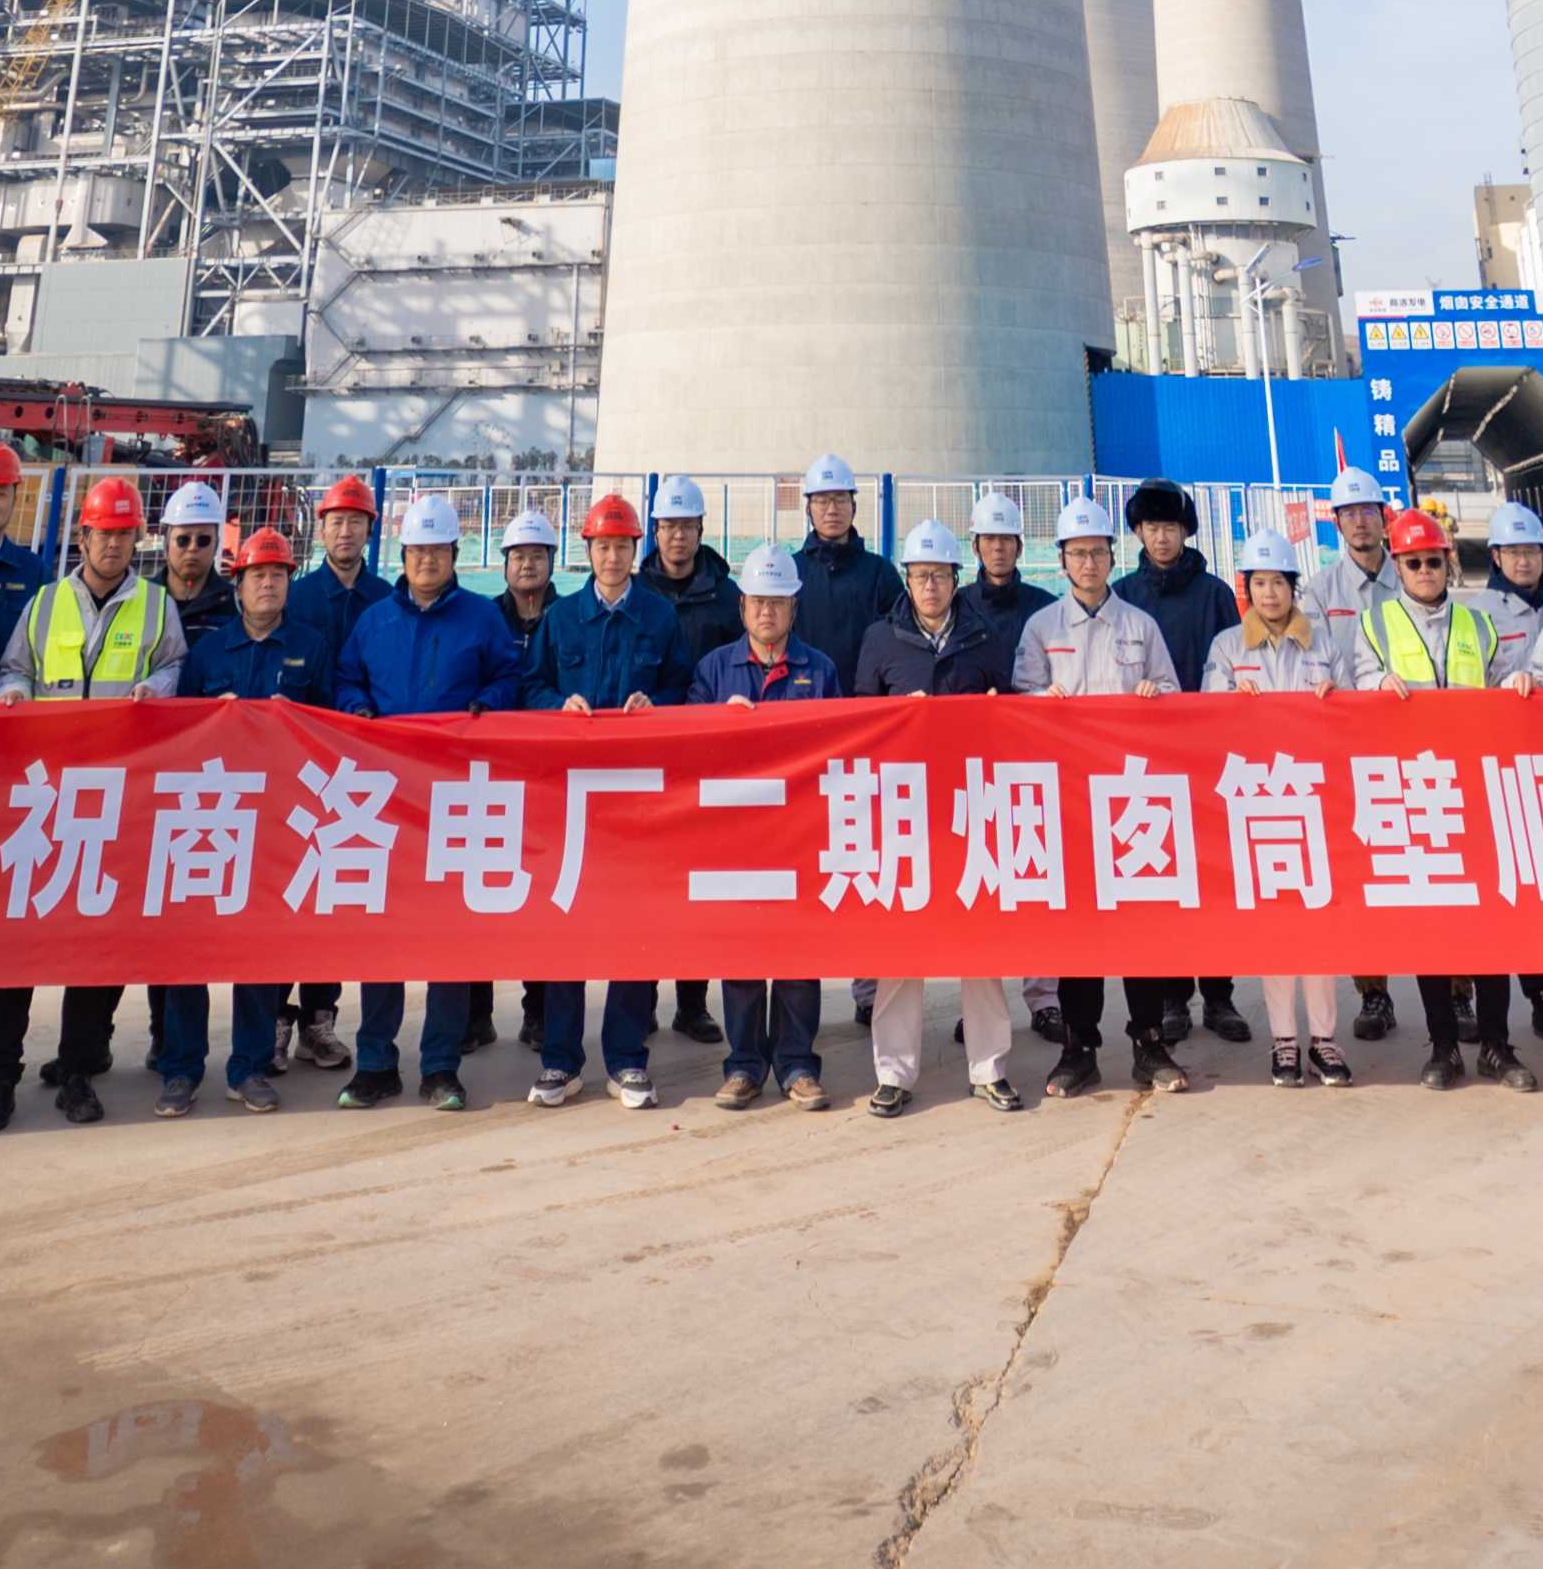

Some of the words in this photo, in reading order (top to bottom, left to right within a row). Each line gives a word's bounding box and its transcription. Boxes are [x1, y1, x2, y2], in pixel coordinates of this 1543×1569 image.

[1439, 294, 1530, 311] 烟囱安全通道
